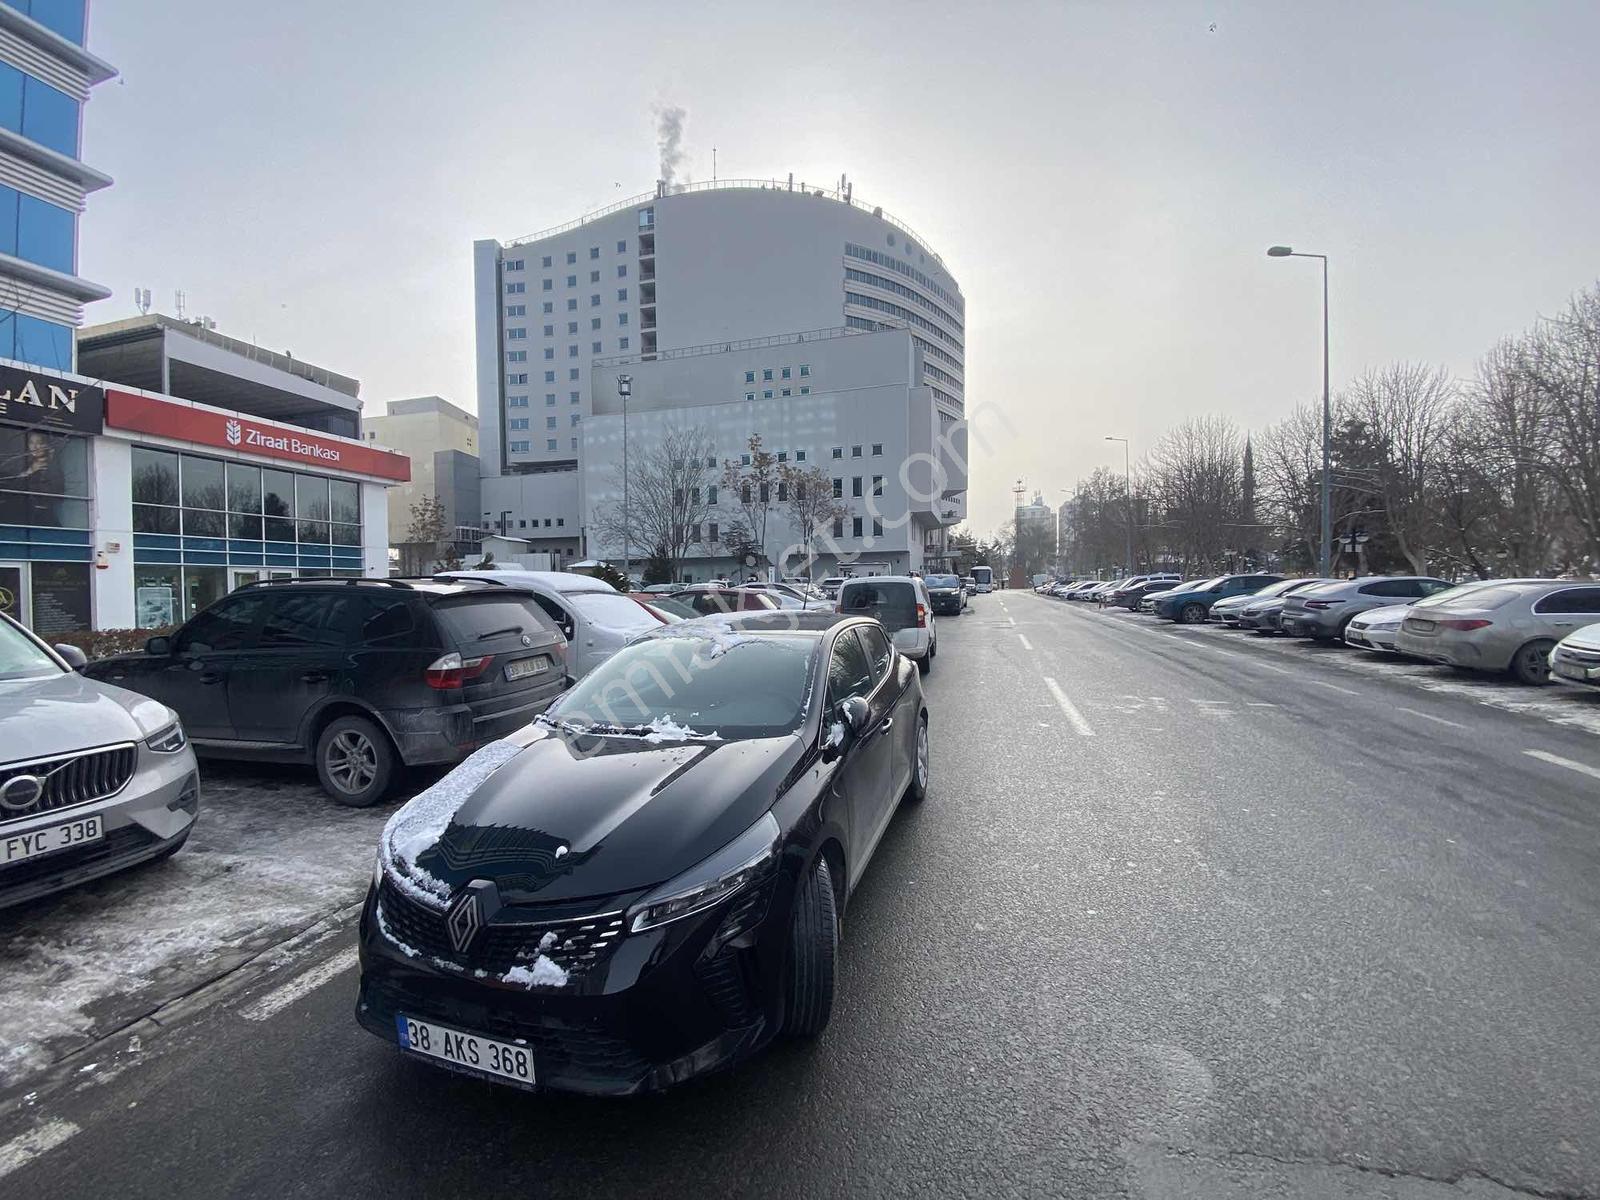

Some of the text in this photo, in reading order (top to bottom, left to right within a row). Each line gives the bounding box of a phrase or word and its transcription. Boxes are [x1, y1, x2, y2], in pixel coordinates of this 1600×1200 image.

[246, 429, 340, 461] Ziraat Bankası
[7, 820, 97, 859] FYC 338
[408, 1022, 528, 1078] 38 AKS 368
